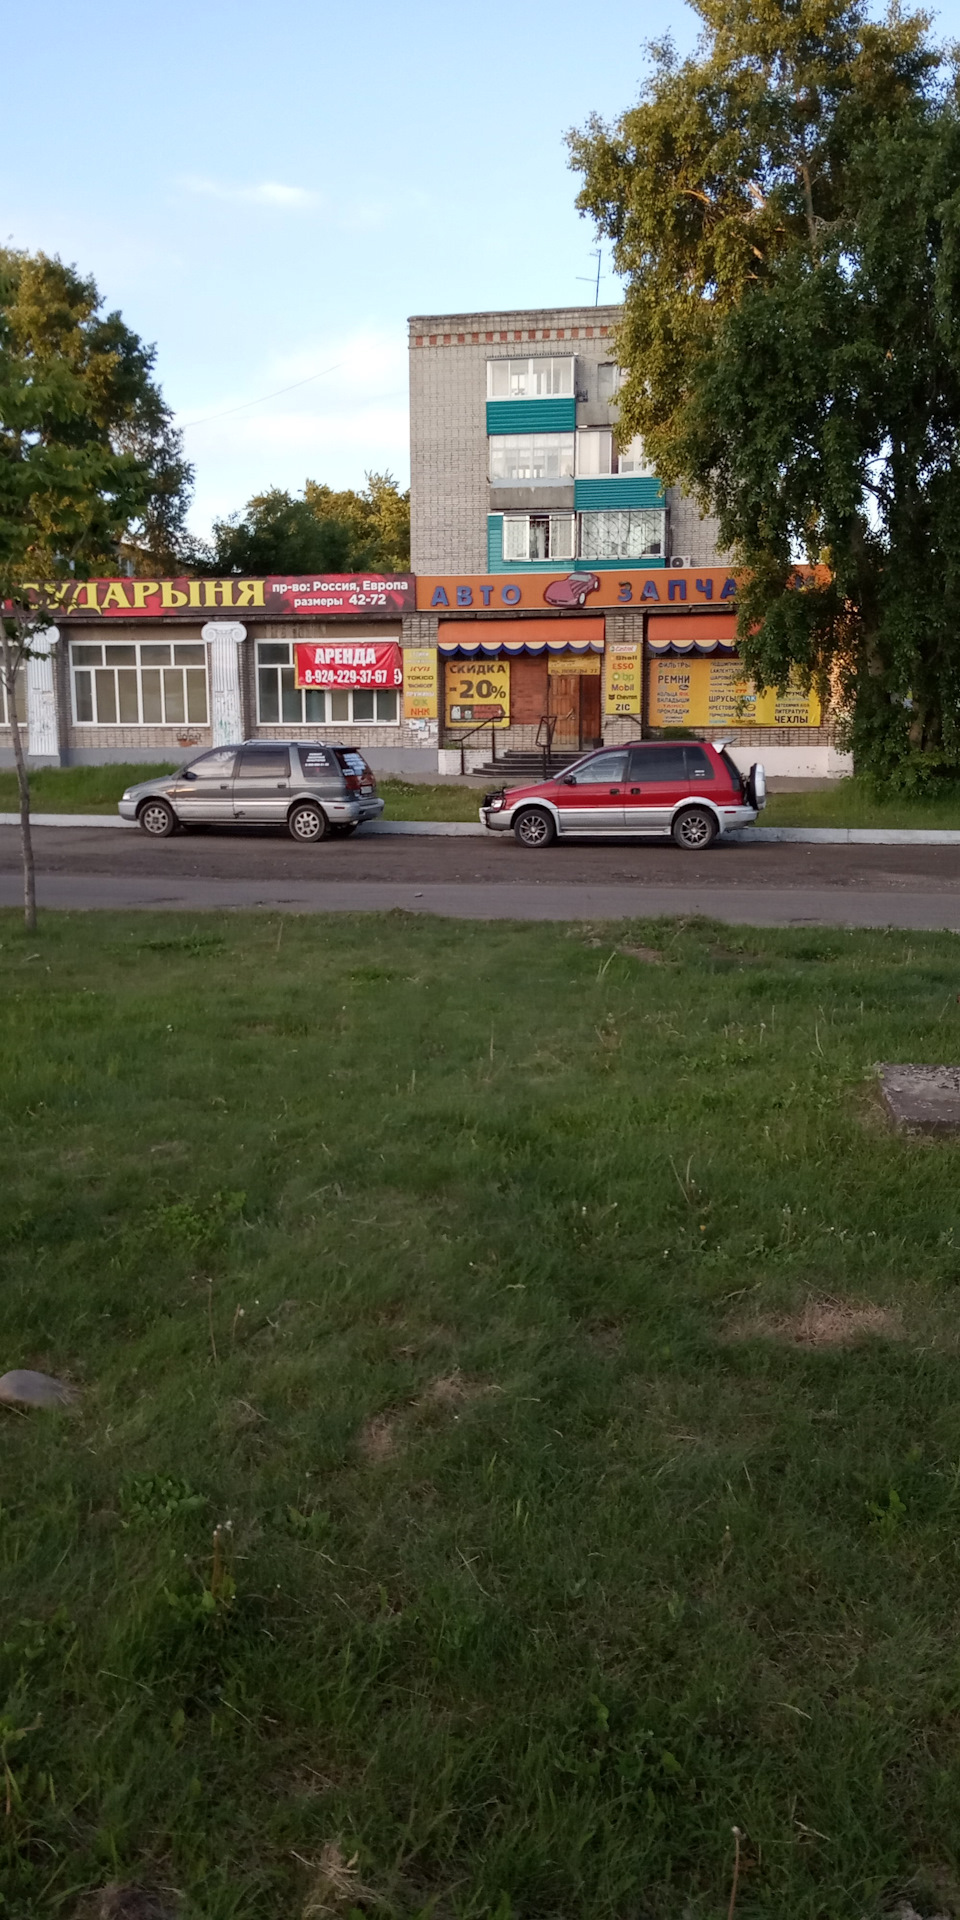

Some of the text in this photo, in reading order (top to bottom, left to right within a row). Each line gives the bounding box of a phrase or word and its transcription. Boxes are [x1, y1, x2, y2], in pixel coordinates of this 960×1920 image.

[313, 581, 360, 593] Россия,
[363, 580, 409, 592] Европа
[294, 594, 387, 608] размеры 42-72
[430, 585, 522, 606] АВТО
[314, 648, 376, 666] АРЕНДА
[450, 664, 506, 675] СКИДКА
[305, 669, 387, 684] 8-924-229-37-67
[622, 672, 634, 682] bp
[658, 675, 690, 684] РЕМНИ
[410, 708, 430, 716] NHK
[774, 716, 808, 724] ЧЕХЛЫ
